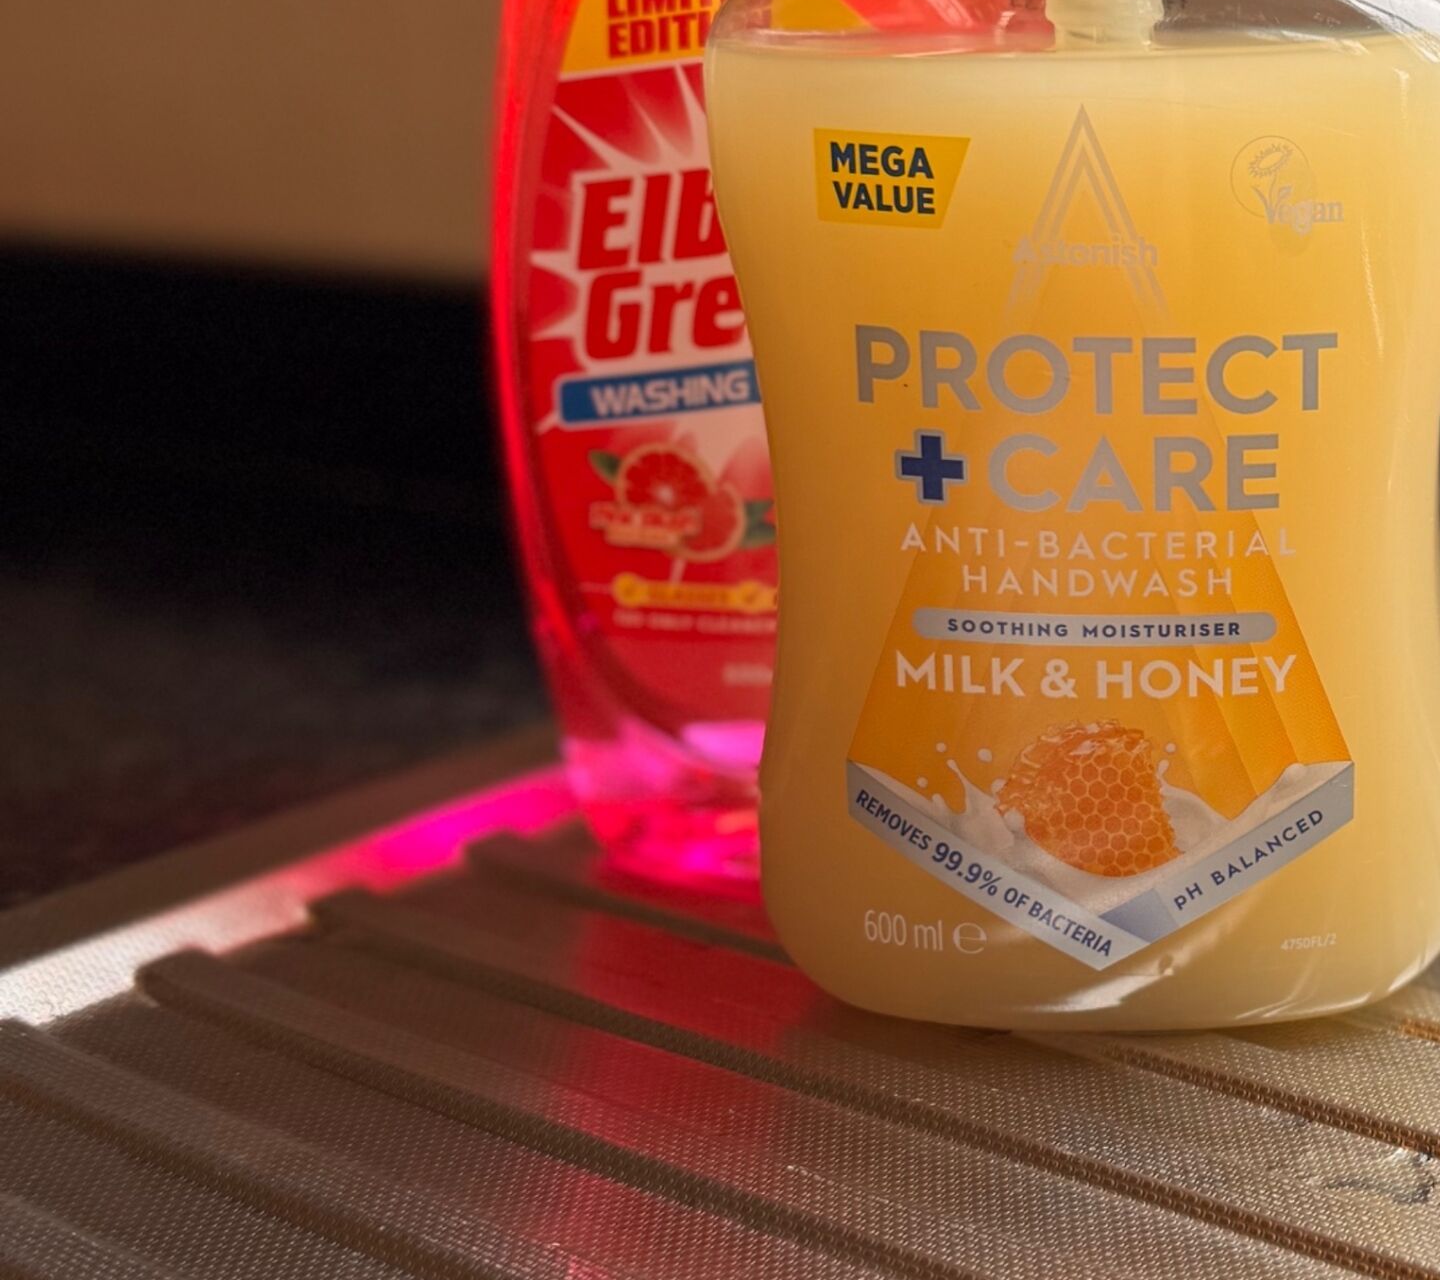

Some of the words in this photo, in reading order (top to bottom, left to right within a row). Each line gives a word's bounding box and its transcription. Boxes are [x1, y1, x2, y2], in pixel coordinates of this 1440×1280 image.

[829, 141, 935, 179] MEGA
[832, 181, 936, 215] VALUE
[1250, 185, 1345, 236] Vegan
[1012, 233, 1159, 268] Astonish
[855, 323, 1339, 416] PROTECT
[590, 371, 749, 417] WASHING
[987, 433, 1281, 514] CARE
[899, 521, 1298, 561] ANTI-BACTERIAL
[961, 564, 1234, 598] HANDWASH
[946, 617, 1069, 638] SOOTHING
[1081, 622, 1242, 639] MOISTURISER
[895, 650, 1026, 699] MILK
[1039, 658, 1079, 699] &
[1096, 653, 1298, 700] HONEY
[1210, 809, 1325, 886] BALANCED
[855, 789, 933, 851] REMOVES
[931, 841, 1004, 898] 99.9%
[1003, 887, 1031, 910] OF
[1028, 901, 1113, 958] BACTERIA
[863, 909, 908, 947] 600
[914, 919, 944, 952] ml
